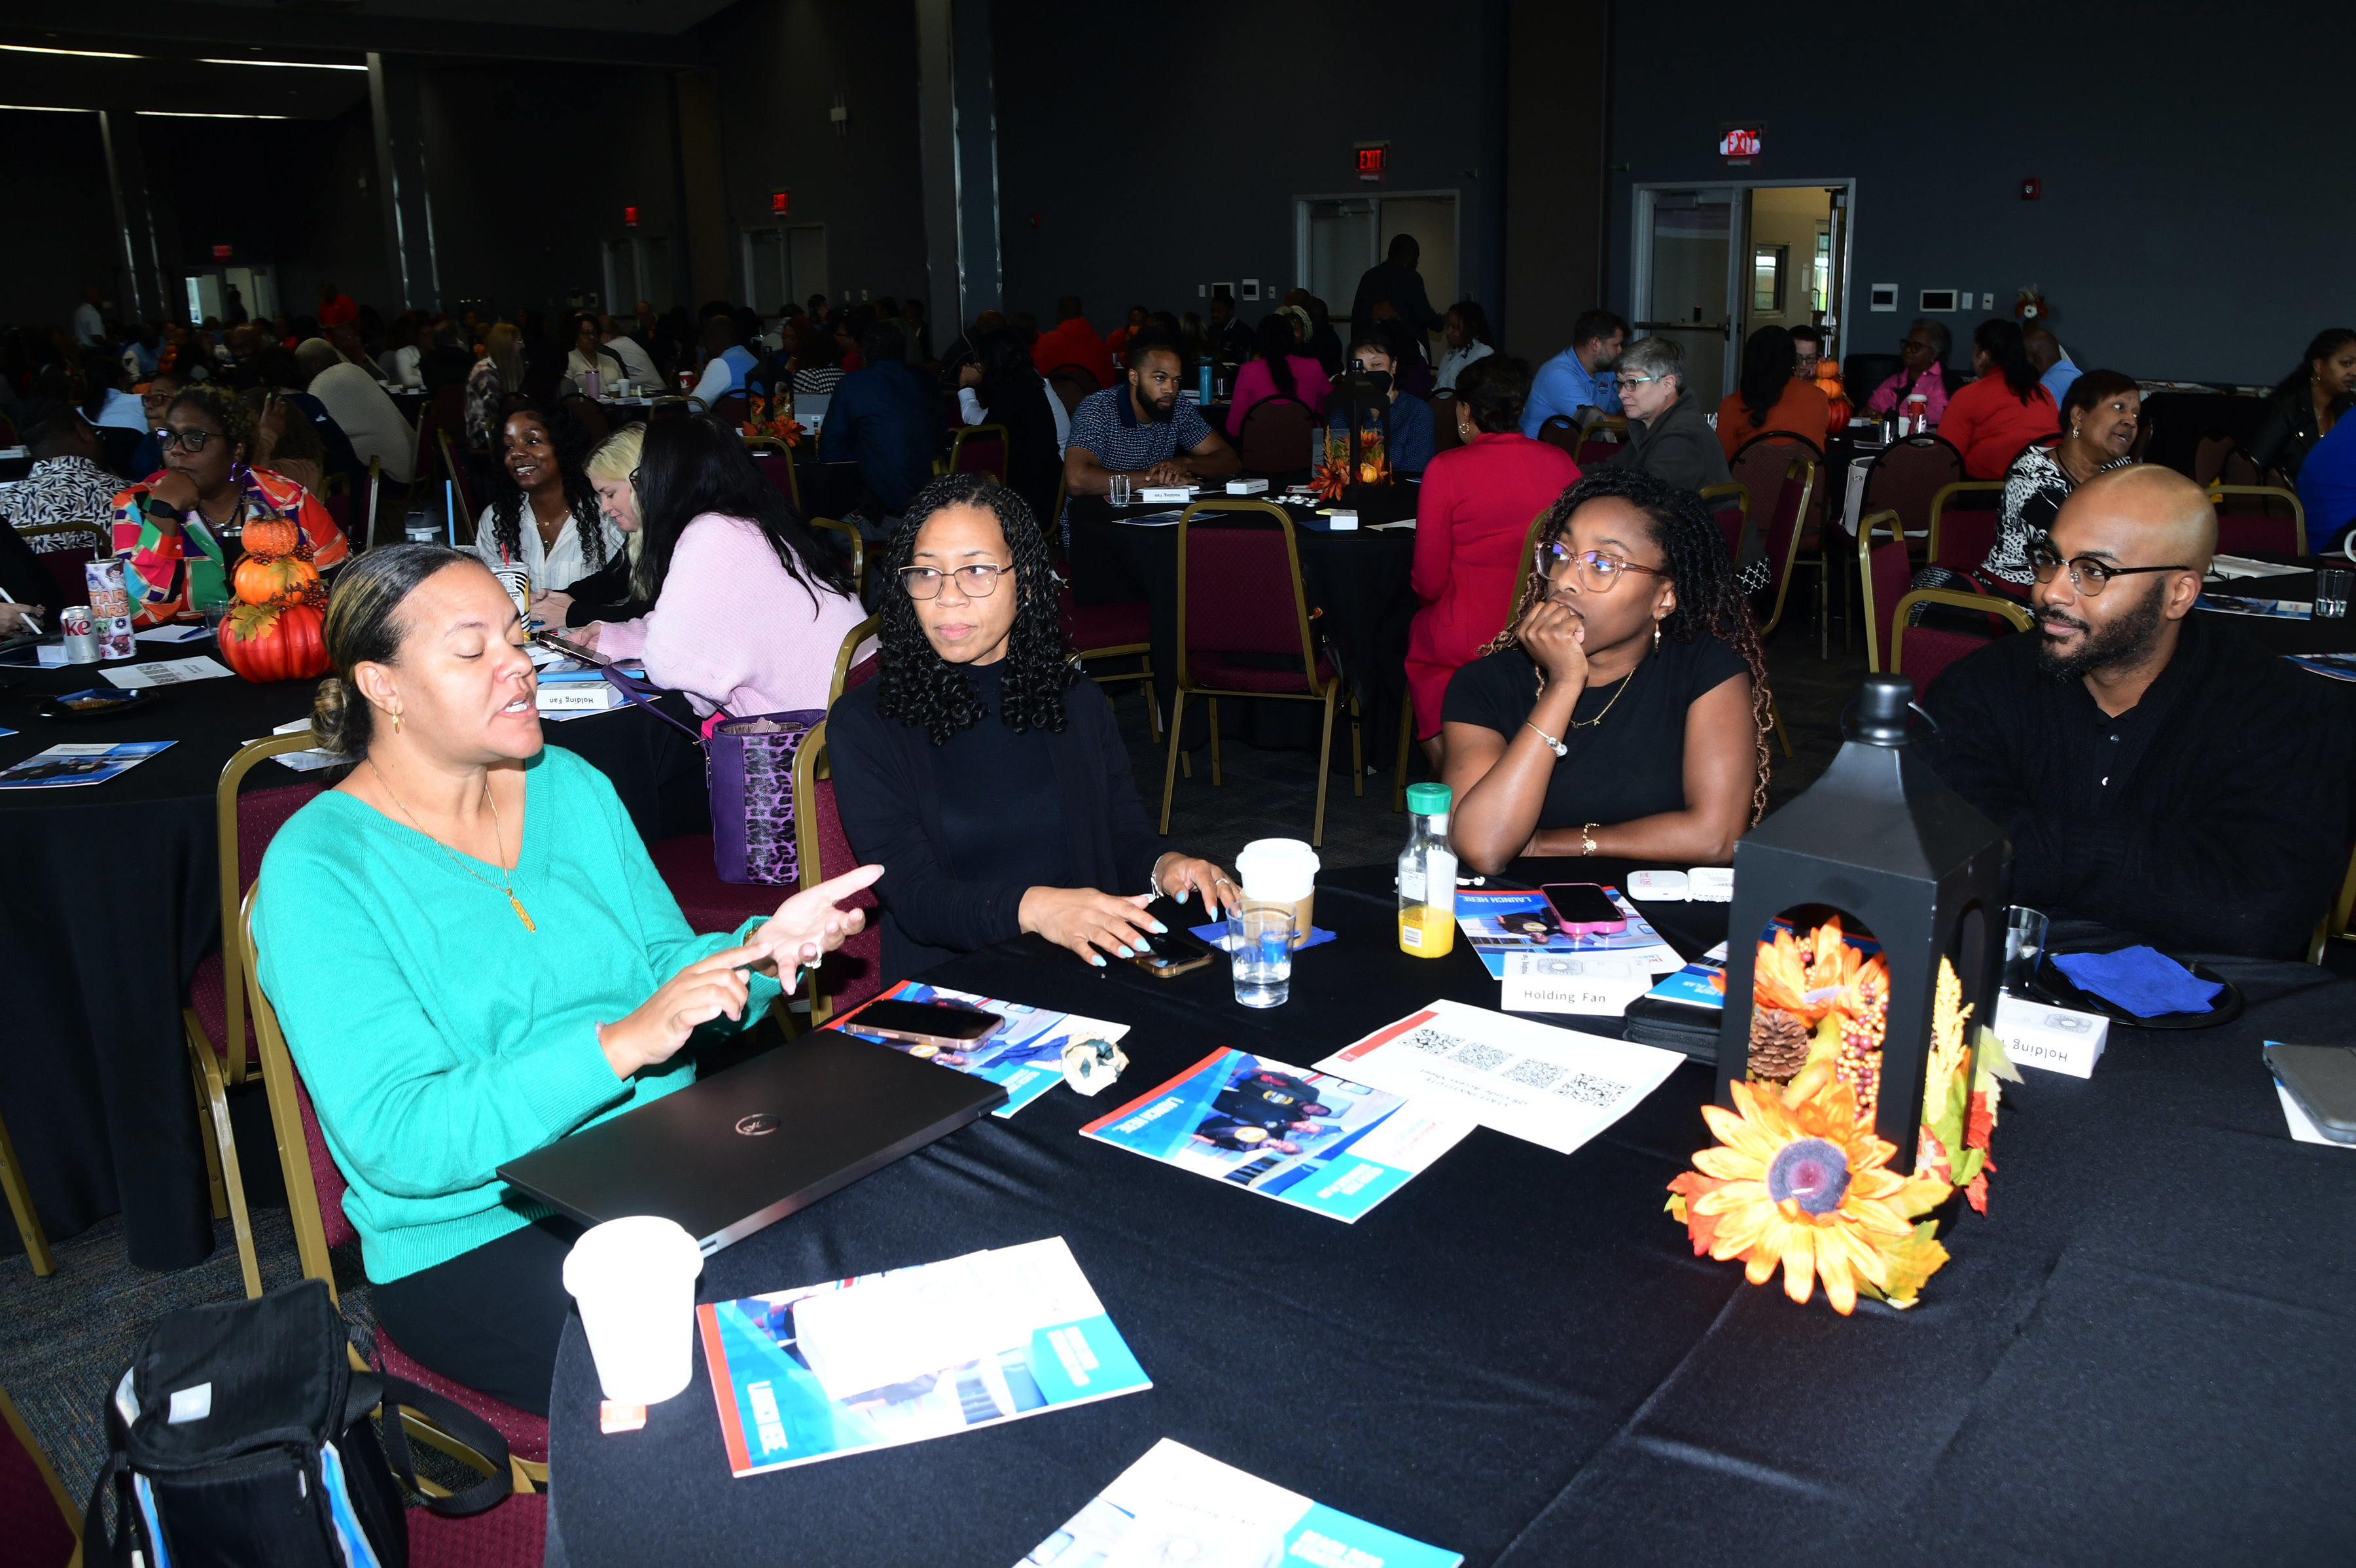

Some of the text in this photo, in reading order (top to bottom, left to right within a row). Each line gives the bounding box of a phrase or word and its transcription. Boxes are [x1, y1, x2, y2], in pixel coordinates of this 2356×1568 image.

[1728, 131, 1756, 154] EXIT
[1360, 150, 1382, 169] EXIT
[89, 589, 128, 604] TAR
[92, 602, 129, 618] ARS
[1524, 989, 1605, 1004] Holding Fan
[2012, 1039, 2068, 1062] Holding
[1419, 1069, 1446, 1080] Sheet
[1450, 1079, 1482, 1090] Access
[1426, 1078, 1508, 1107] STAFF INSTITUTE
[1484, 1090, 1509, 1099] Code
